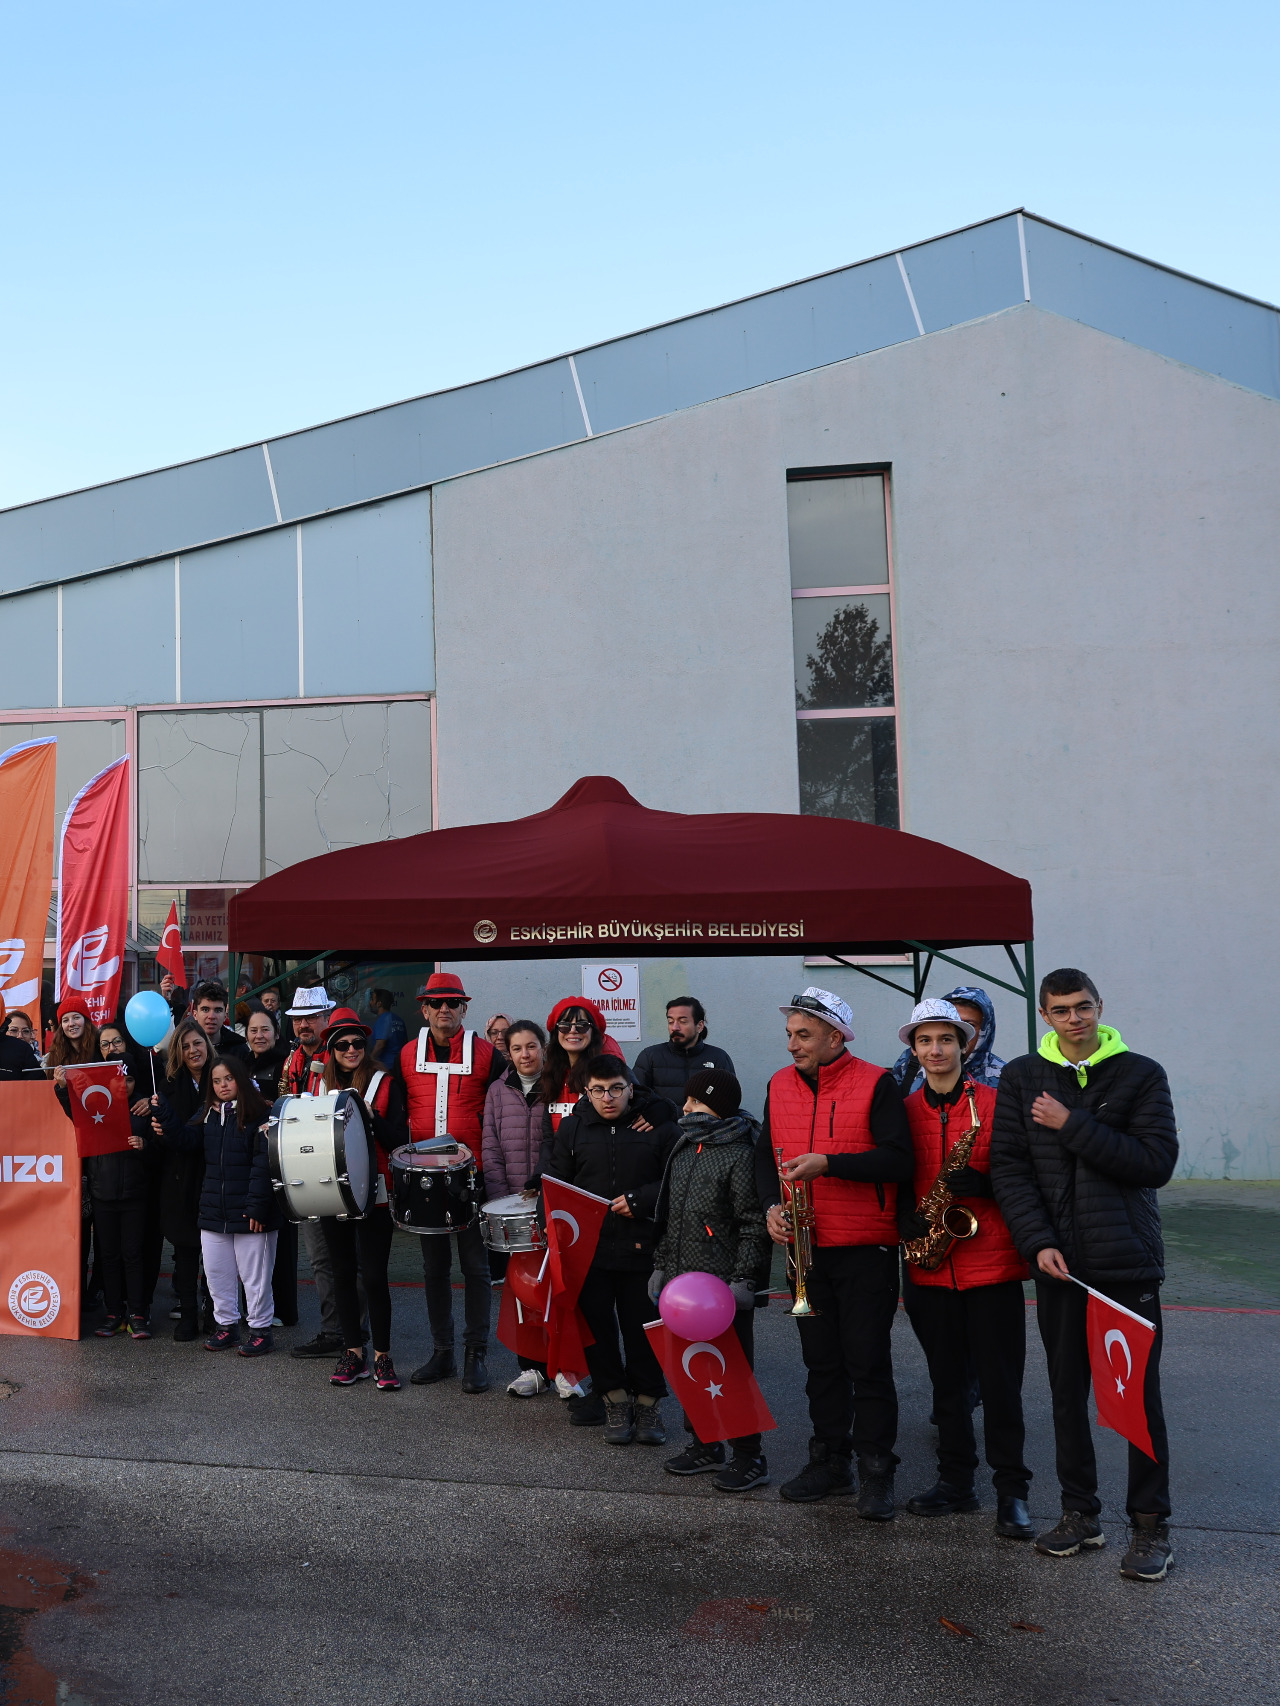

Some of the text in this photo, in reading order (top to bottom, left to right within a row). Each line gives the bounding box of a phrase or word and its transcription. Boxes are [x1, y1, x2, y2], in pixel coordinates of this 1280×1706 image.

[510, 922, 594, 942] ESKİŞEHİR
[598, 920, 703, 940] BÜYÜKŞEHİR
[708, 920, 804, 938] BELEDİYESİ
[611, 997, 636, 1012] İÇİLMEZ
